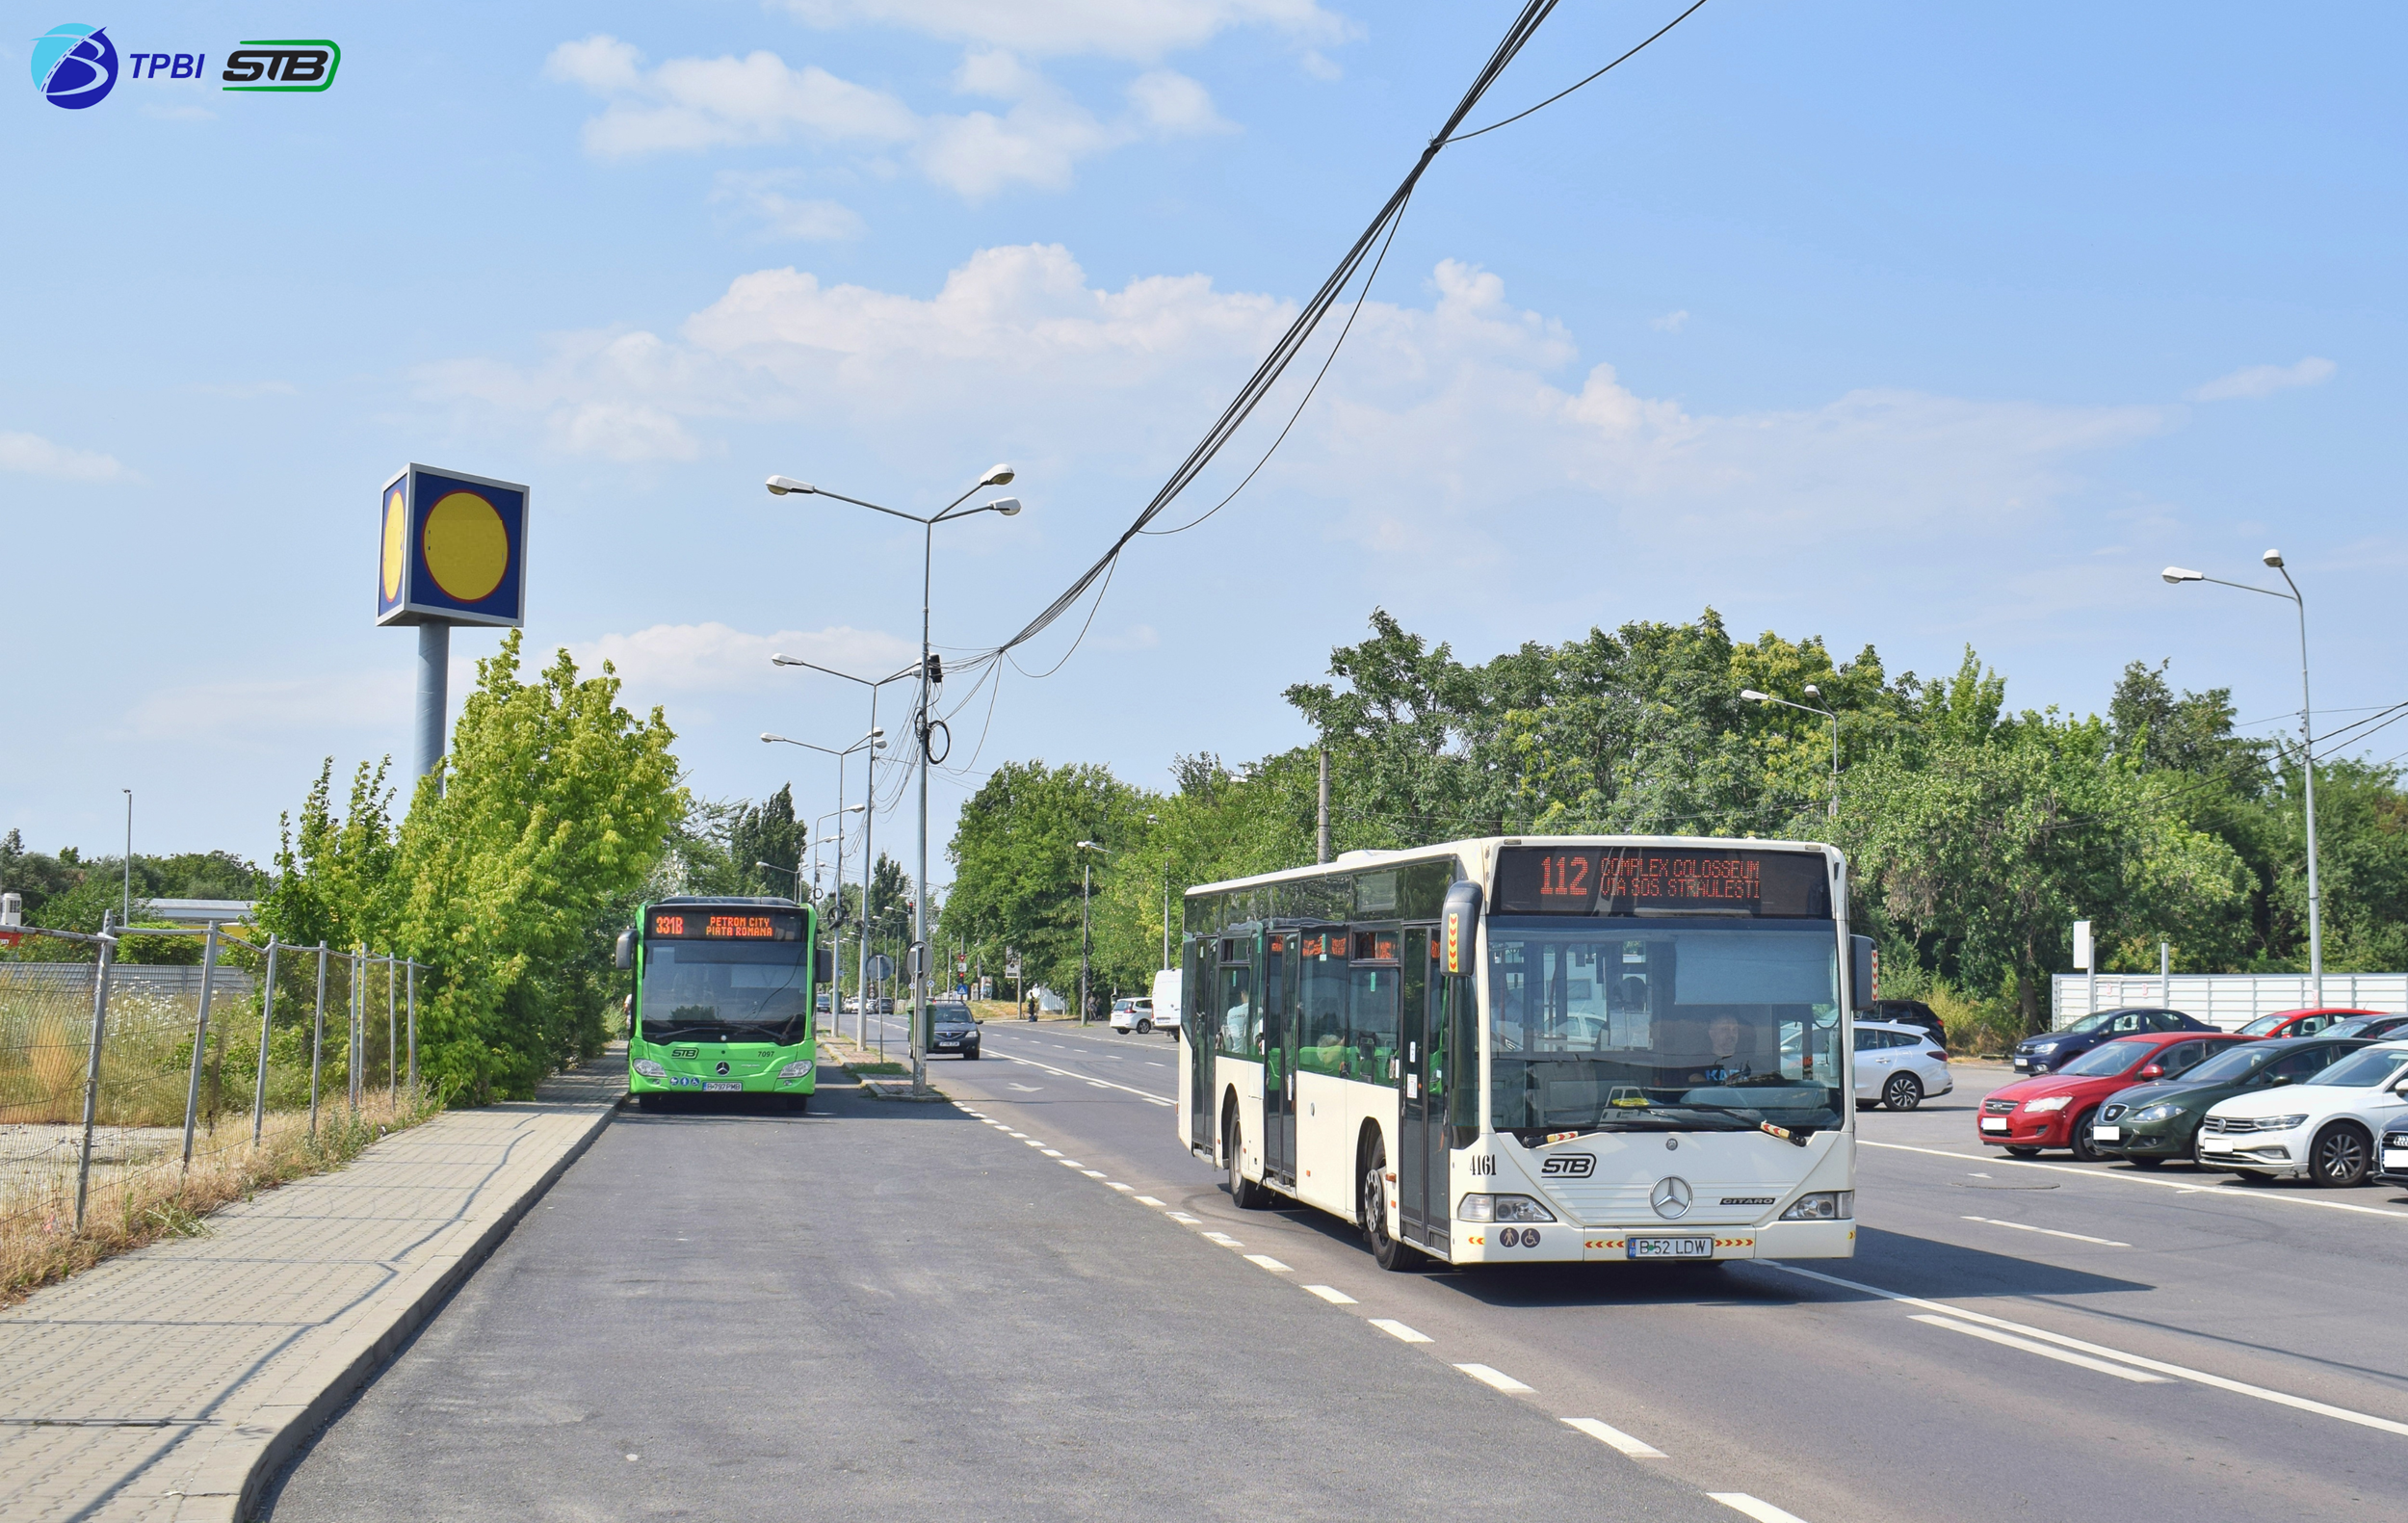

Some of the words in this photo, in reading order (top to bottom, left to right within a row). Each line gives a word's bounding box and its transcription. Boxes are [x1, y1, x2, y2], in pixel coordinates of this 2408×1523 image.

[1540, 856, 1588, 896] 112
[1601, 857, 1668, 878] COMPLEX
[1673, 859, 1760, 879] COLOSSEUM
[1600, 878, 1626, 896] VIA
[1667, 879, 1760, 898] STRAULESTI
[656, 916, 683, 934] 331B
[710, 916, 746, 927] PETROM
[748, 917, 770, 928] CITY
[706, 926, 734, 936] PIATA
[735, 927, 773, 937] ROMANA
[671, 1049, 696, 1058] STB
[1469, 1154, 1497, 1175] 4161
[1541, 1158, 1591, 1173] STB
[1639, 1240, 1650, 1254] B
[1654, 1240, 1671, 1254] 52
[1676, 1240, 1706, 1254] LDW
